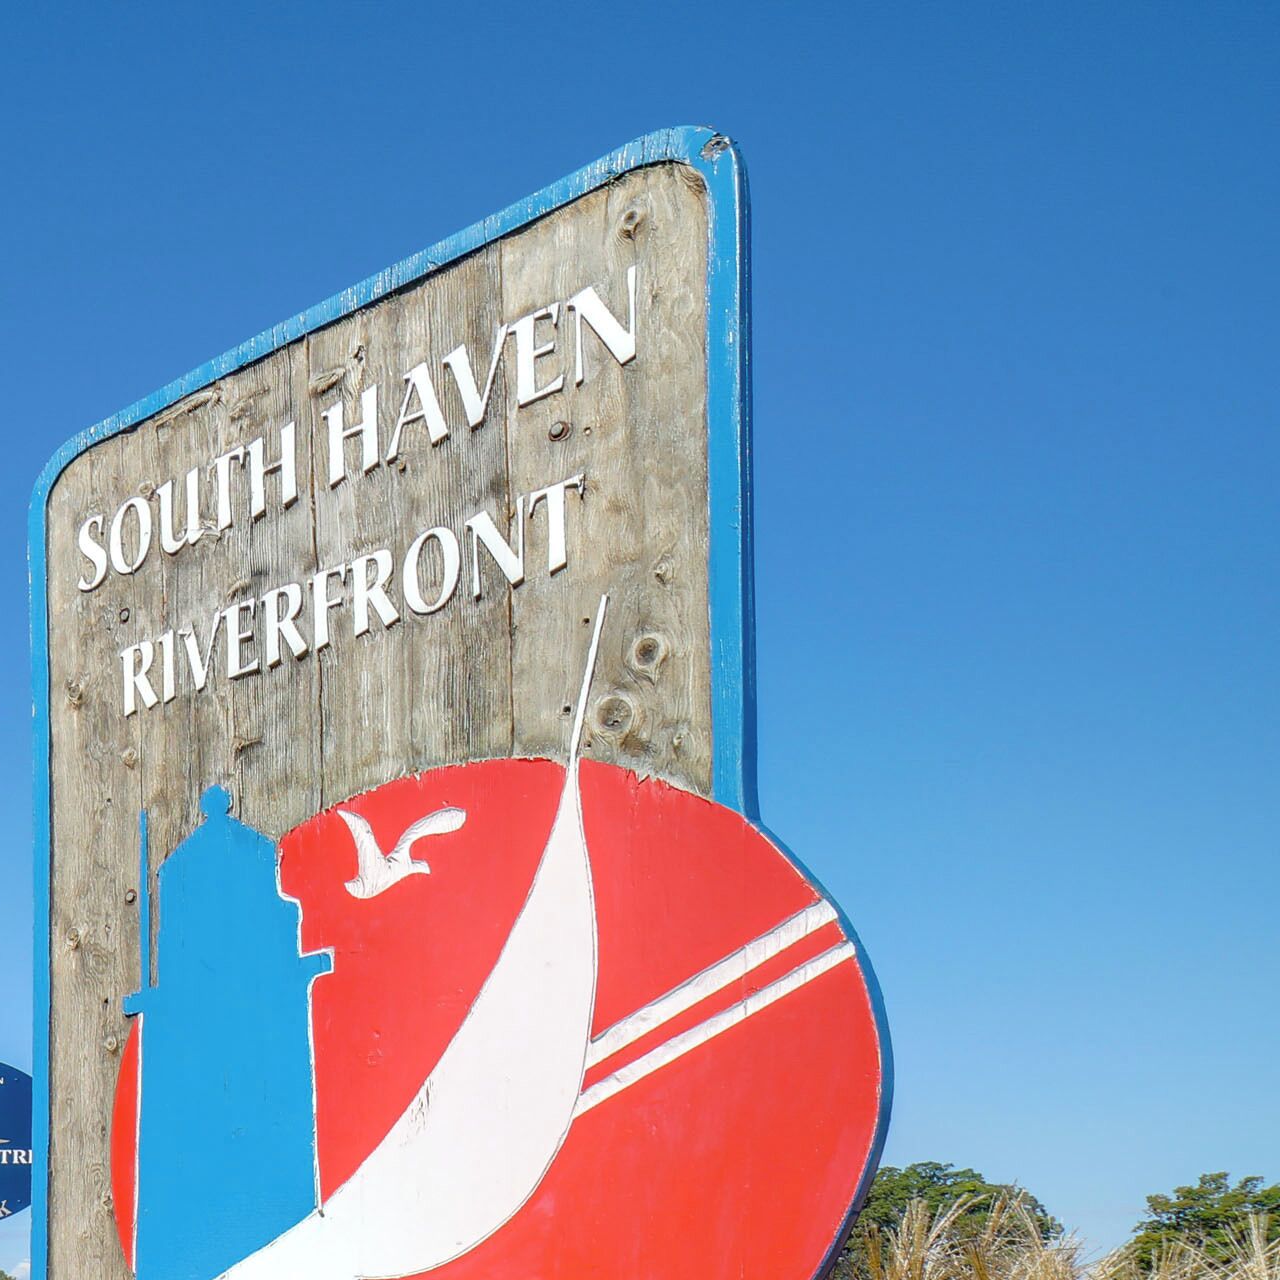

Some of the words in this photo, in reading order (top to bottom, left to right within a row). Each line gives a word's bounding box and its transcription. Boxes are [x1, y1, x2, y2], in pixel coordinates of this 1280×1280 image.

[77, 421, 299, 593] SOUTH
[320, 266, 637, 489] HAVEN
[119, 474, 586, 718] RIVERFRONT
